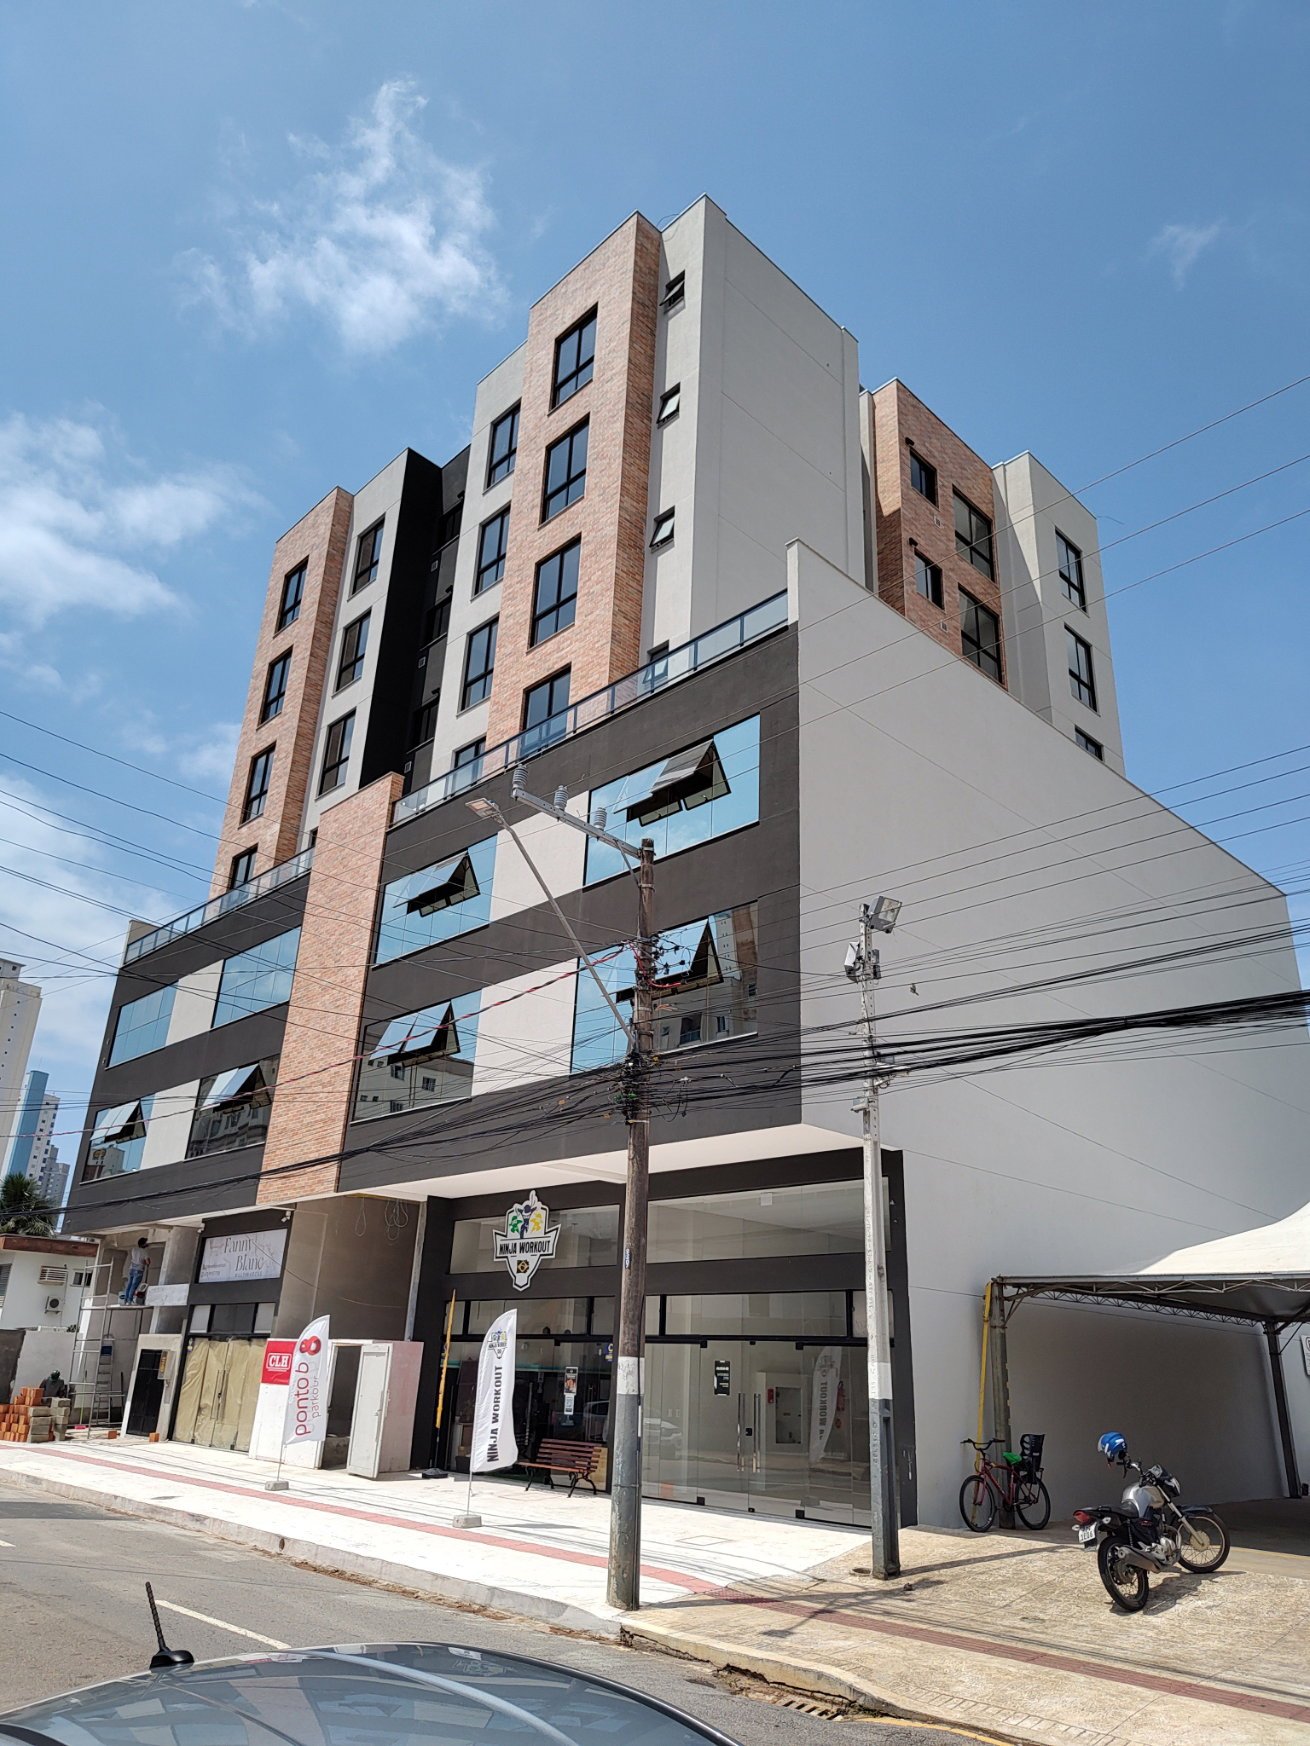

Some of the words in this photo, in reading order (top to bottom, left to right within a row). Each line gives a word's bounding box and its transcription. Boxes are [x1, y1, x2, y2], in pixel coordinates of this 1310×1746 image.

[500, 1243, 517, 1255] NINJA
[519, 1240, 551, 1254] WORKOUT
[269, 1355, 289, 1367] CLH
[295, 1377, 311, 1436] ponto
[311, 1376, 321, 1418] parkour
[491, 1366, 502, 1424] WORKOUT
[487, 1427, 499, 1462] NINJA
